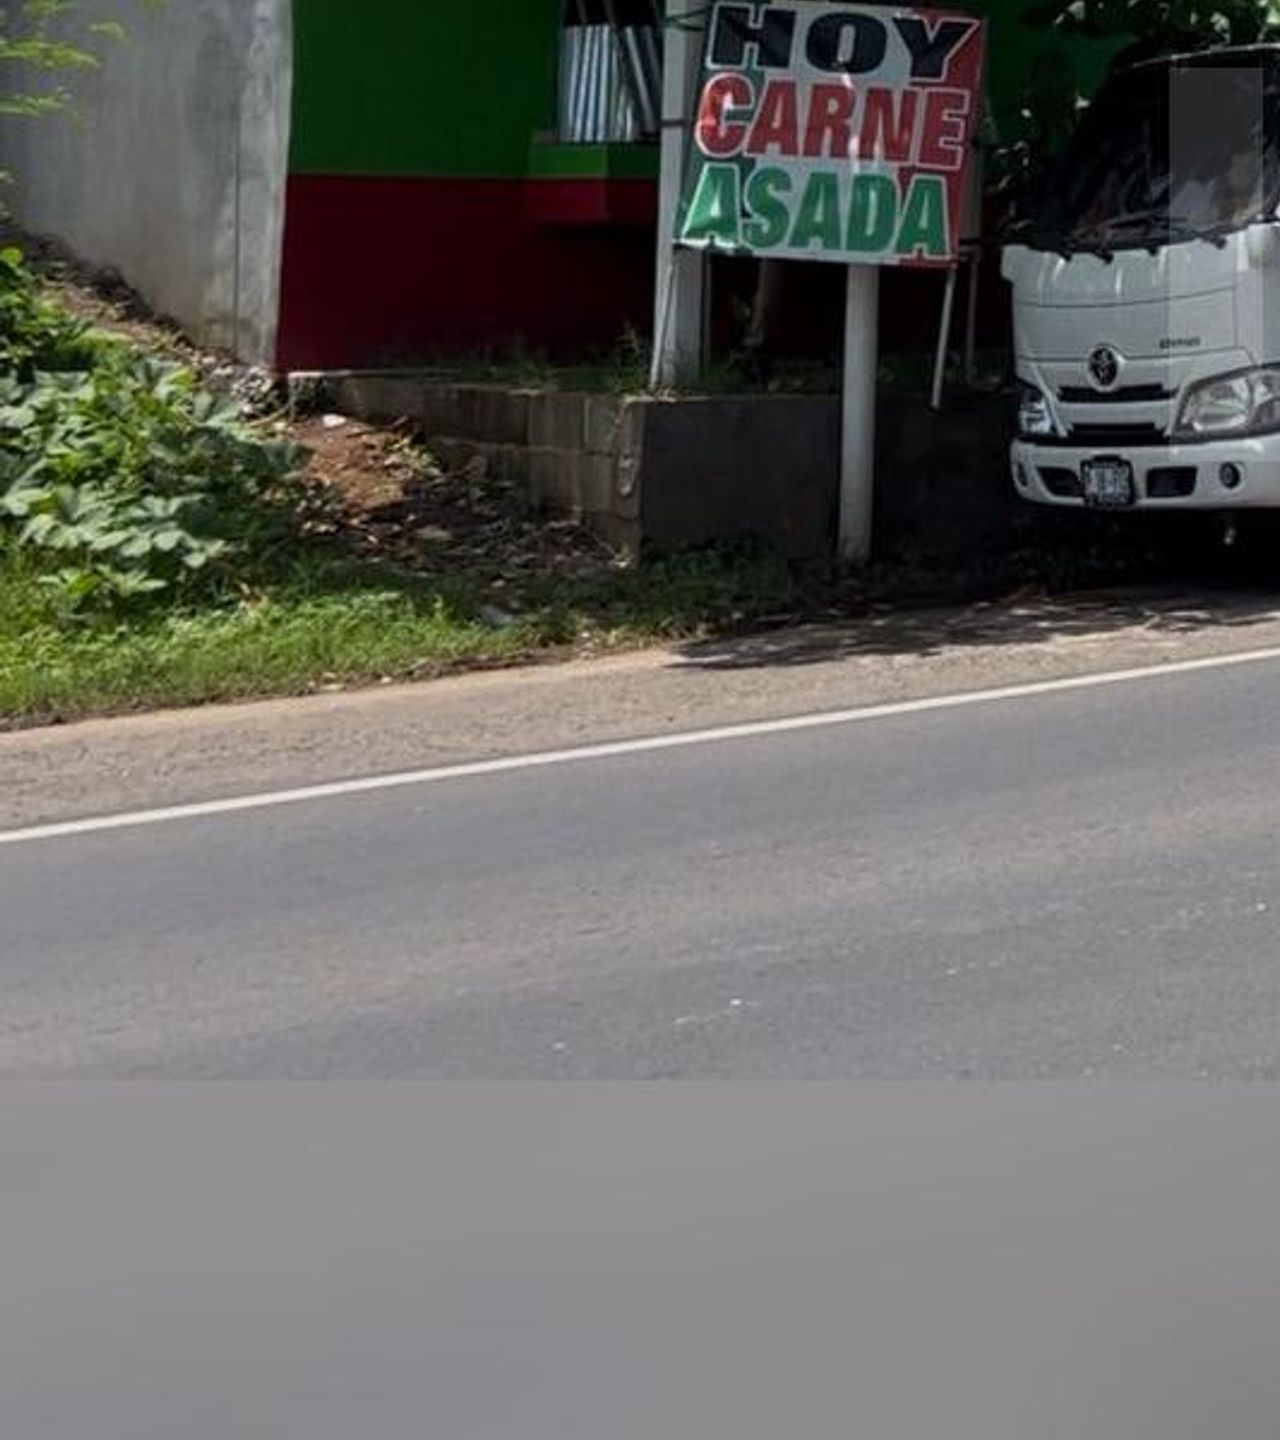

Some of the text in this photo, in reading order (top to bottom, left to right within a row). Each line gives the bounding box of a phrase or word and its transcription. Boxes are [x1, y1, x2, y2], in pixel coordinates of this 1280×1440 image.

[706, 3, 980, 82] HOY
[695, 73, 970, 169] CARNE
[676, 162, 952, 260] ASADA
